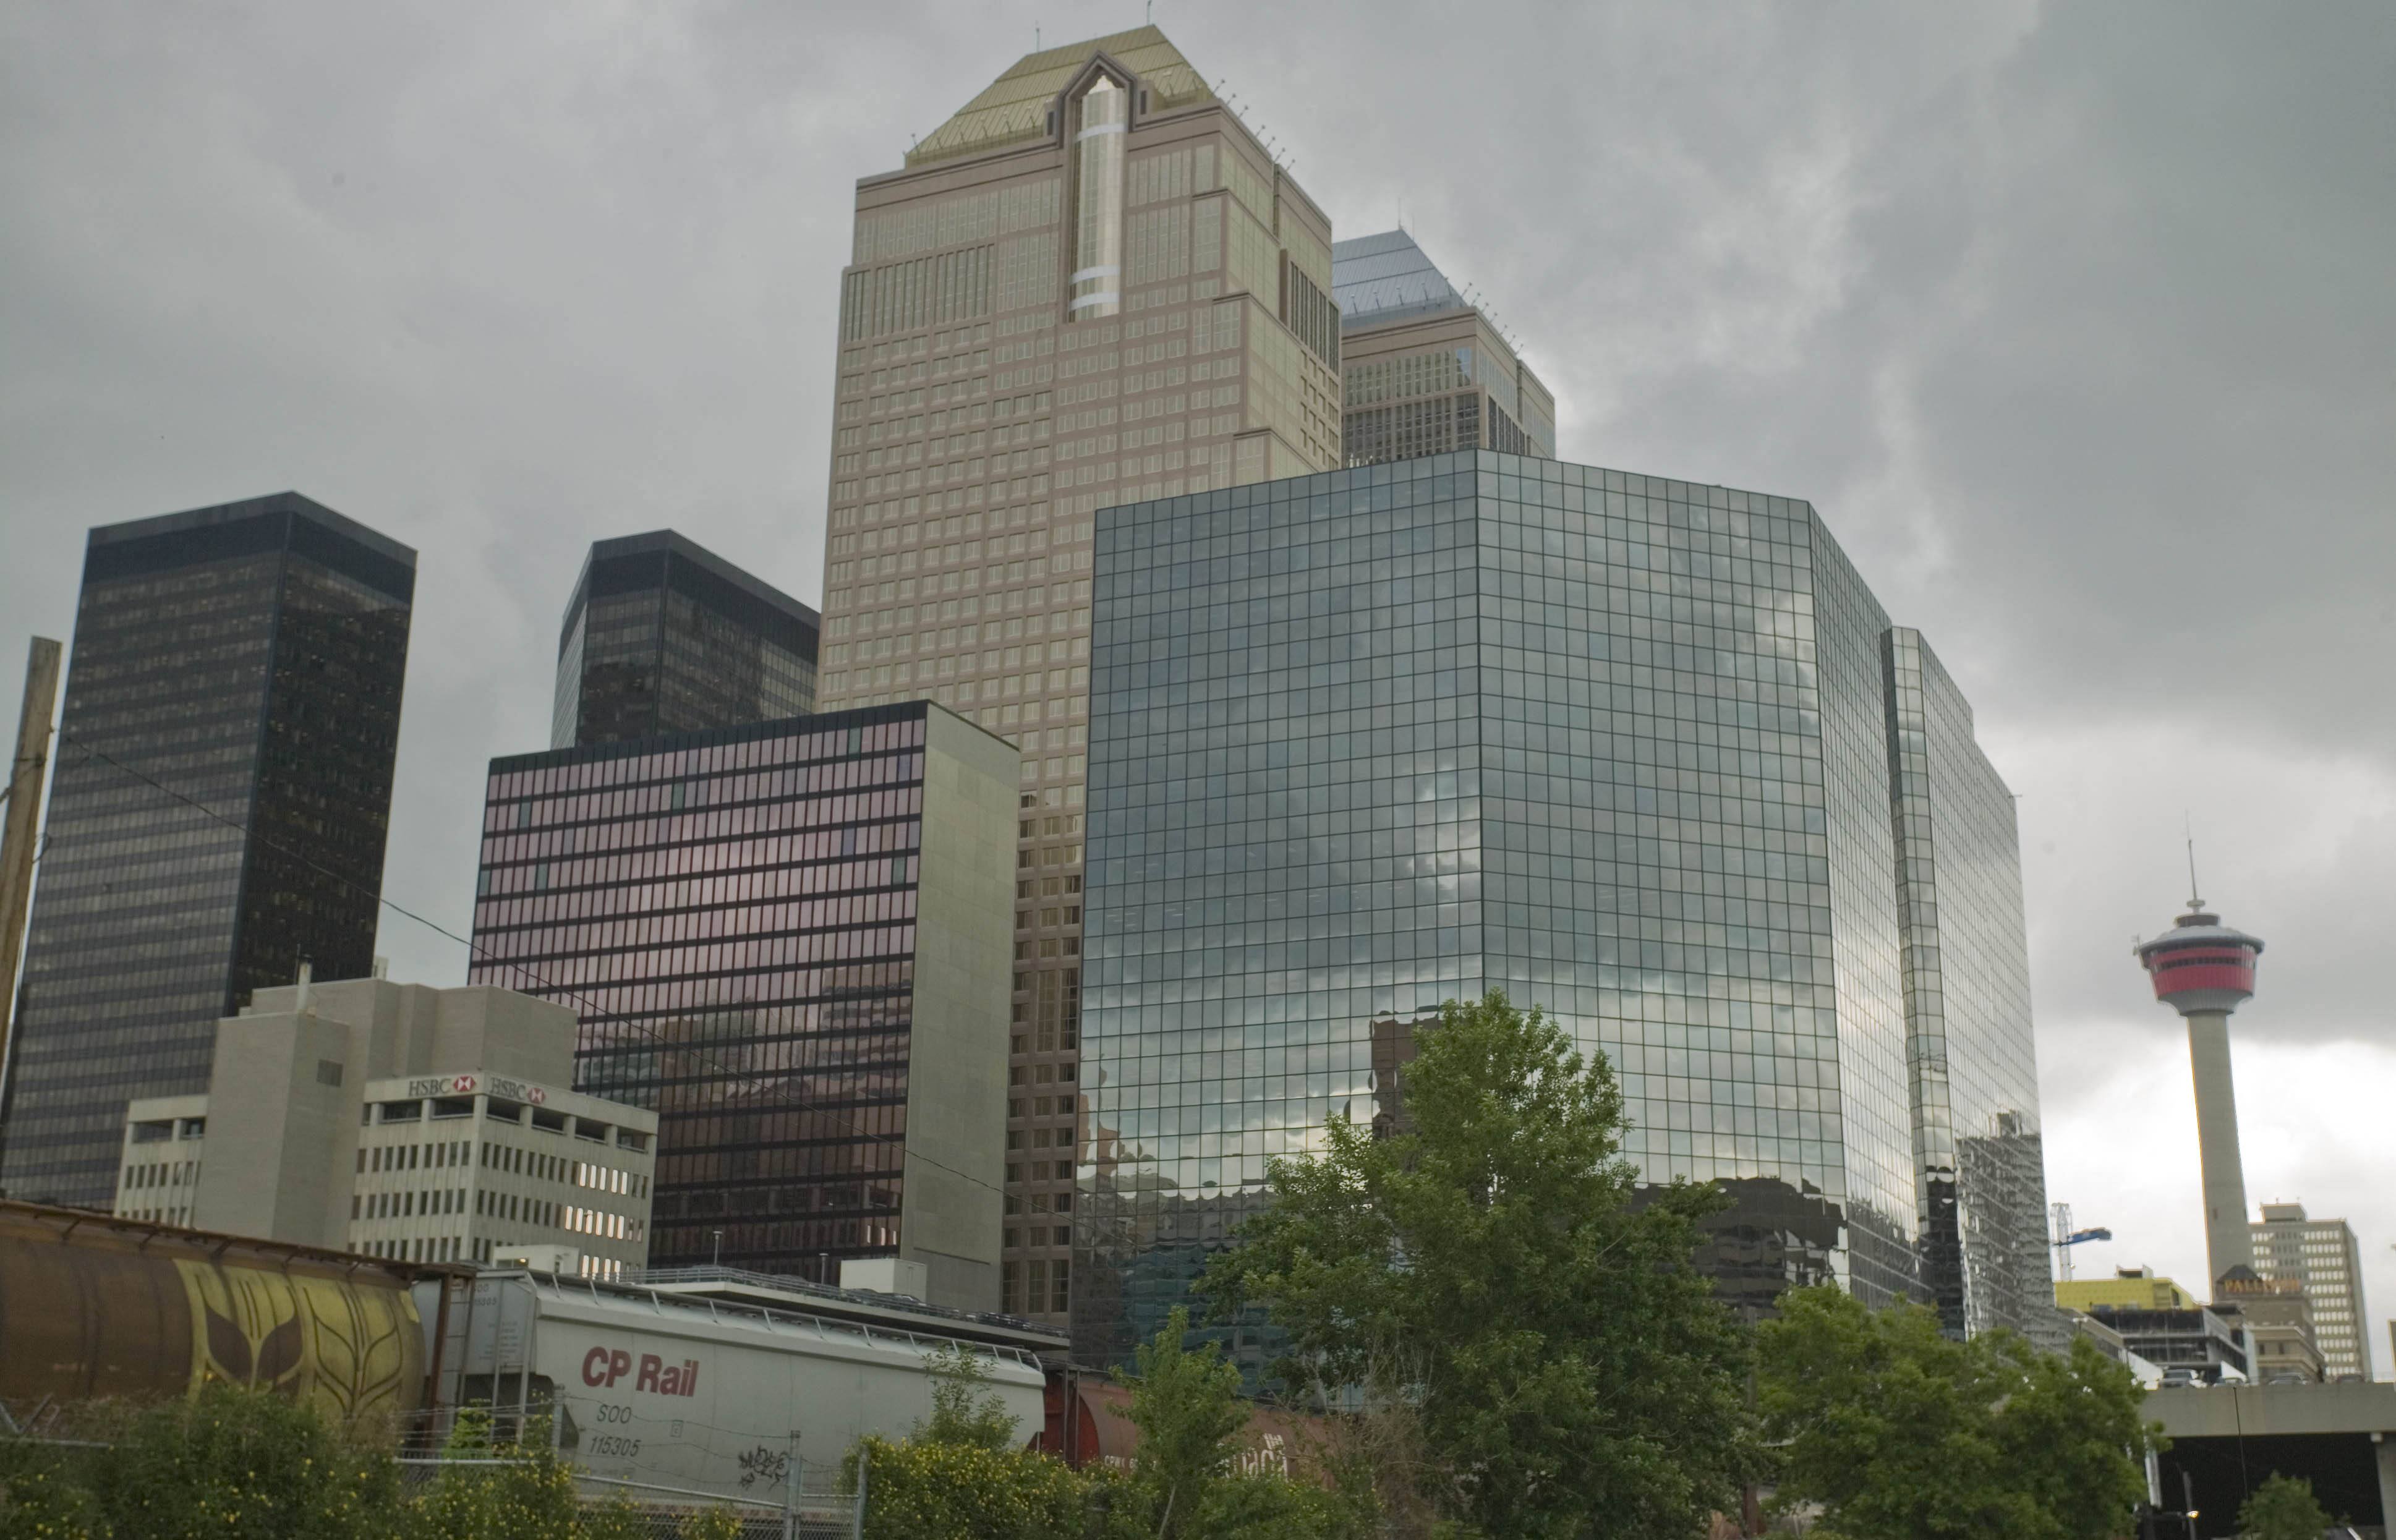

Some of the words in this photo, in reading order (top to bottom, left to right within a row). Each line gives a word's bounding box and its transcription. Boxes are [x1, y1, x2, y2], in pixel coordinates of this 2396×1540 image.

[408, 1078, 451, 1097] HSBC
[490, 1077, 525, 1099] HSBC
[581, 1346, 632, 1389] CP
[636, 1353, 699, 1397] Rail
[597, 1403, 632, 1424] SOO
[590, 1436, 642, 1457] 115305
